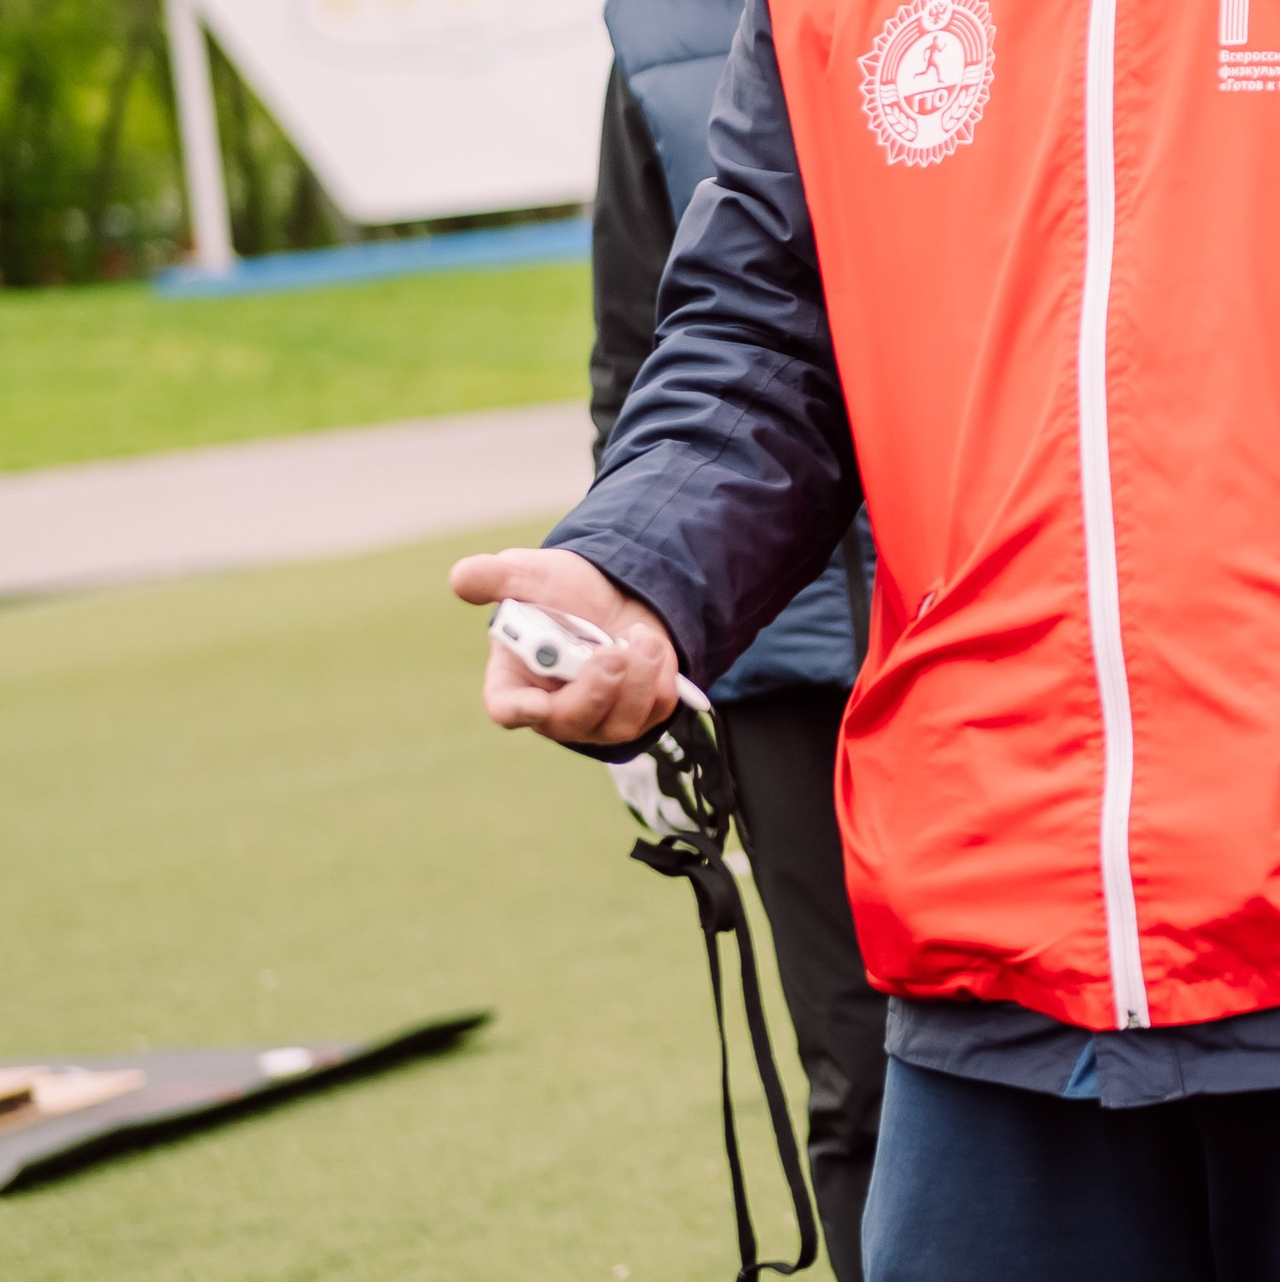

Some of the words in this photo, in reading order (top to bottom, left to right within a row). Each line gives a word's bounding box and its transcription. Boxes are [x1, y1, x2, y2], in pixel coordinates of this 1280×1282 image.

[1218, 78, 1264, 92] «Готов
[1266, 80, 1276, 91] к
[914, 88, 949, 113] ГТО
